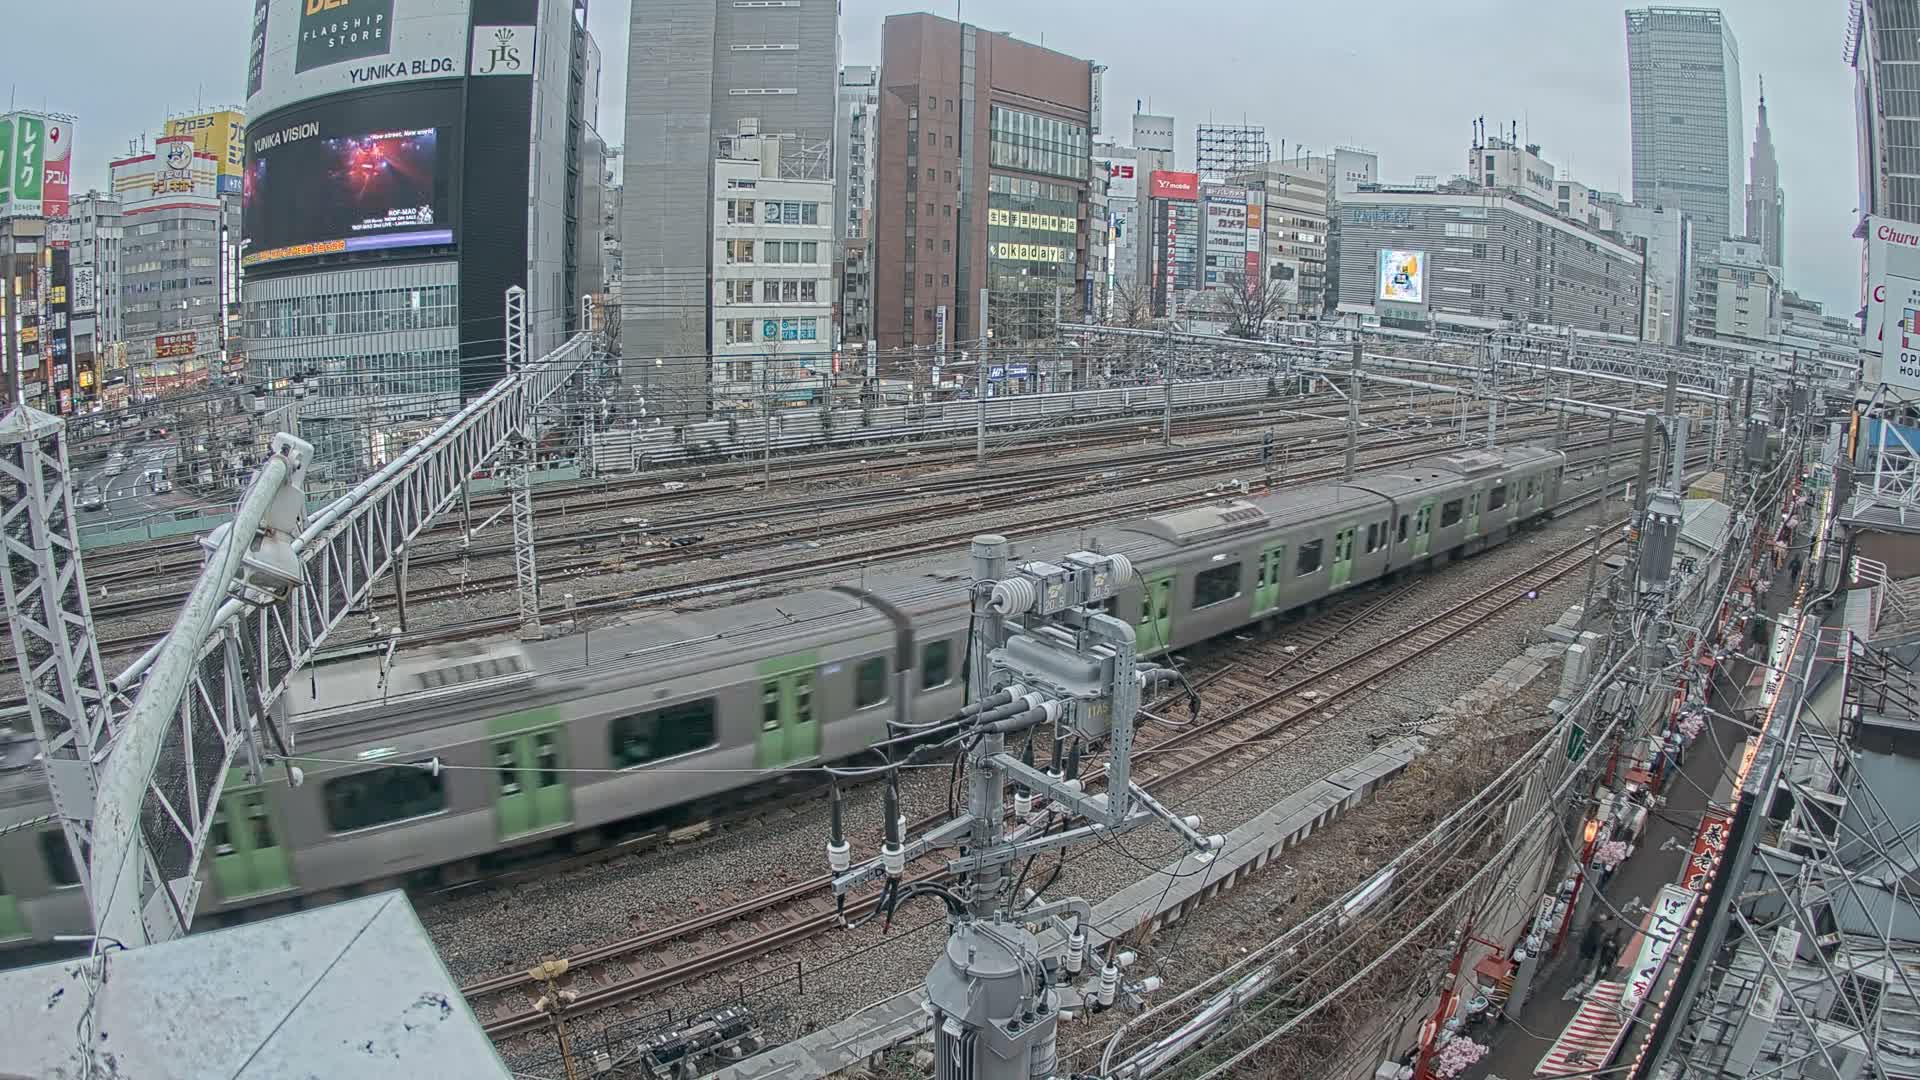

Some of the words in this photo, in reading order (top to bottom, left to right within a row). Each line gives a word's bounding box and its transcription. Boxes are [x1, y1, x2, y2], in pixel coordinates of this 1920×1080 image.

[304, 14, 383, 41] FLAGSHIP
[328, 28, 382, 48] STORE
[349, 62, 408, 83] YUNIKA
[411, 57, 456, 75] BLDG.
[175, 117, 214, 132] プロミス
[254, 131, 282, 153] YUNIKA
[282, 121, 320, 145] VISION
[22, 121, 37, 188] レイク
[46, 169, 68, 185] アコム
[1000, 246, 1065, 260] okadaya
